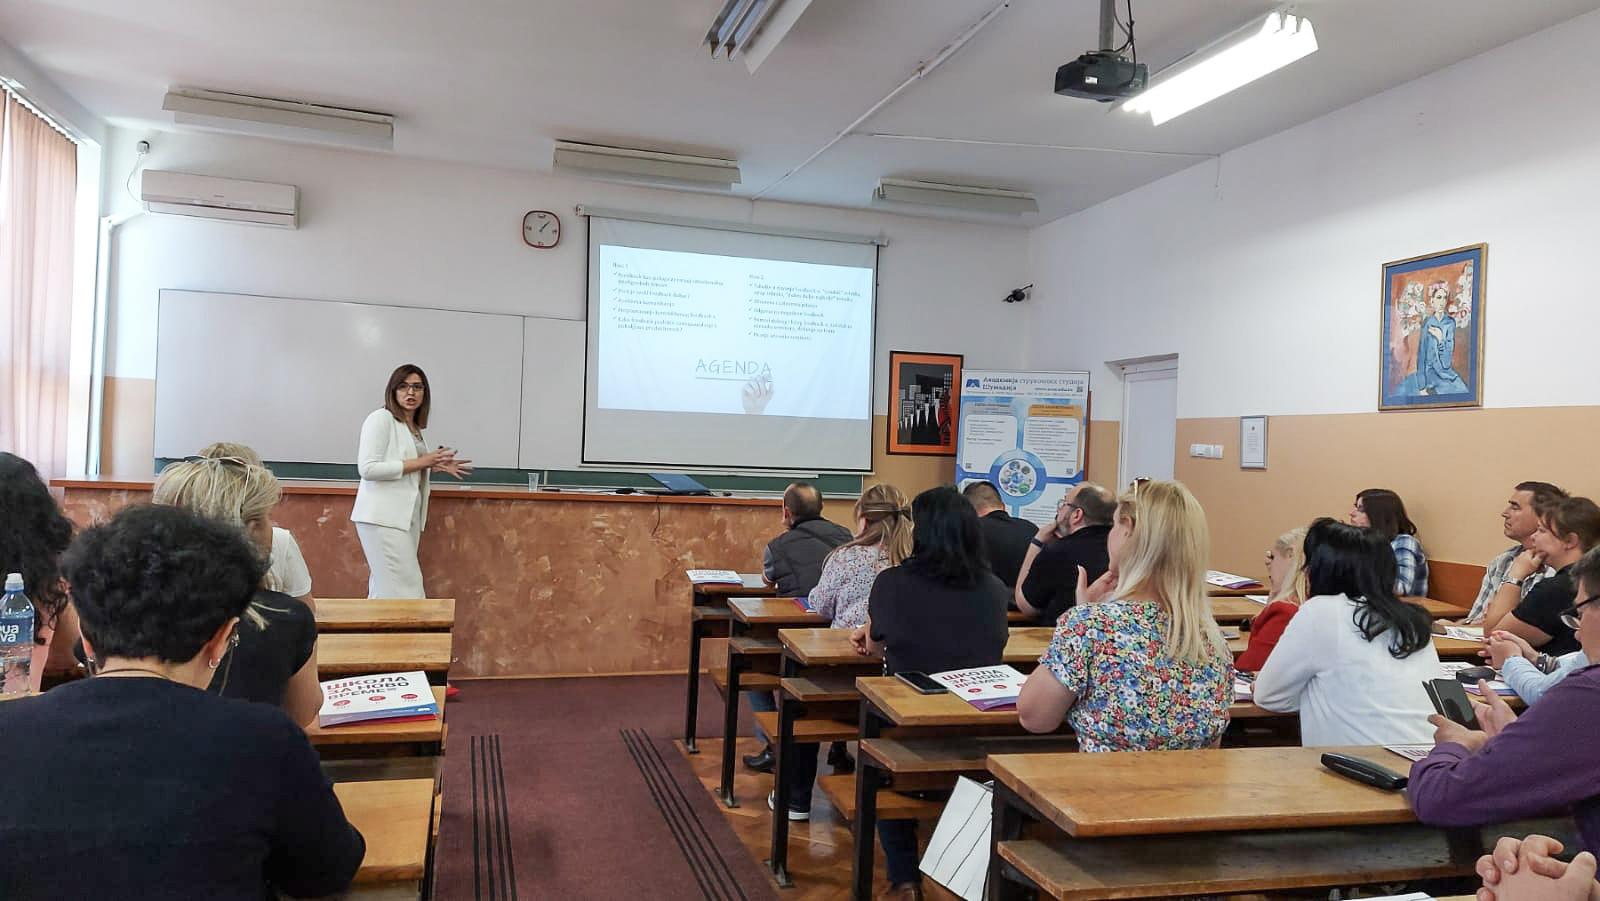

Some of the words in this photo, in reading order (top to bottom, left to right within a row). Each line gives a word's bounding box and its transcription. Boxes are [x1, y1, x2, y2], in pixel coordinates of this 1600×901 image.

[695, 359, 773, 377] AGENDA
[0, 624, 19, 634] ua
[942, 669, 1001, 680] ШКОЛА
[326, 676, 408, 690] ШКОЛА
[358, 681, 409, 690] НОВО
